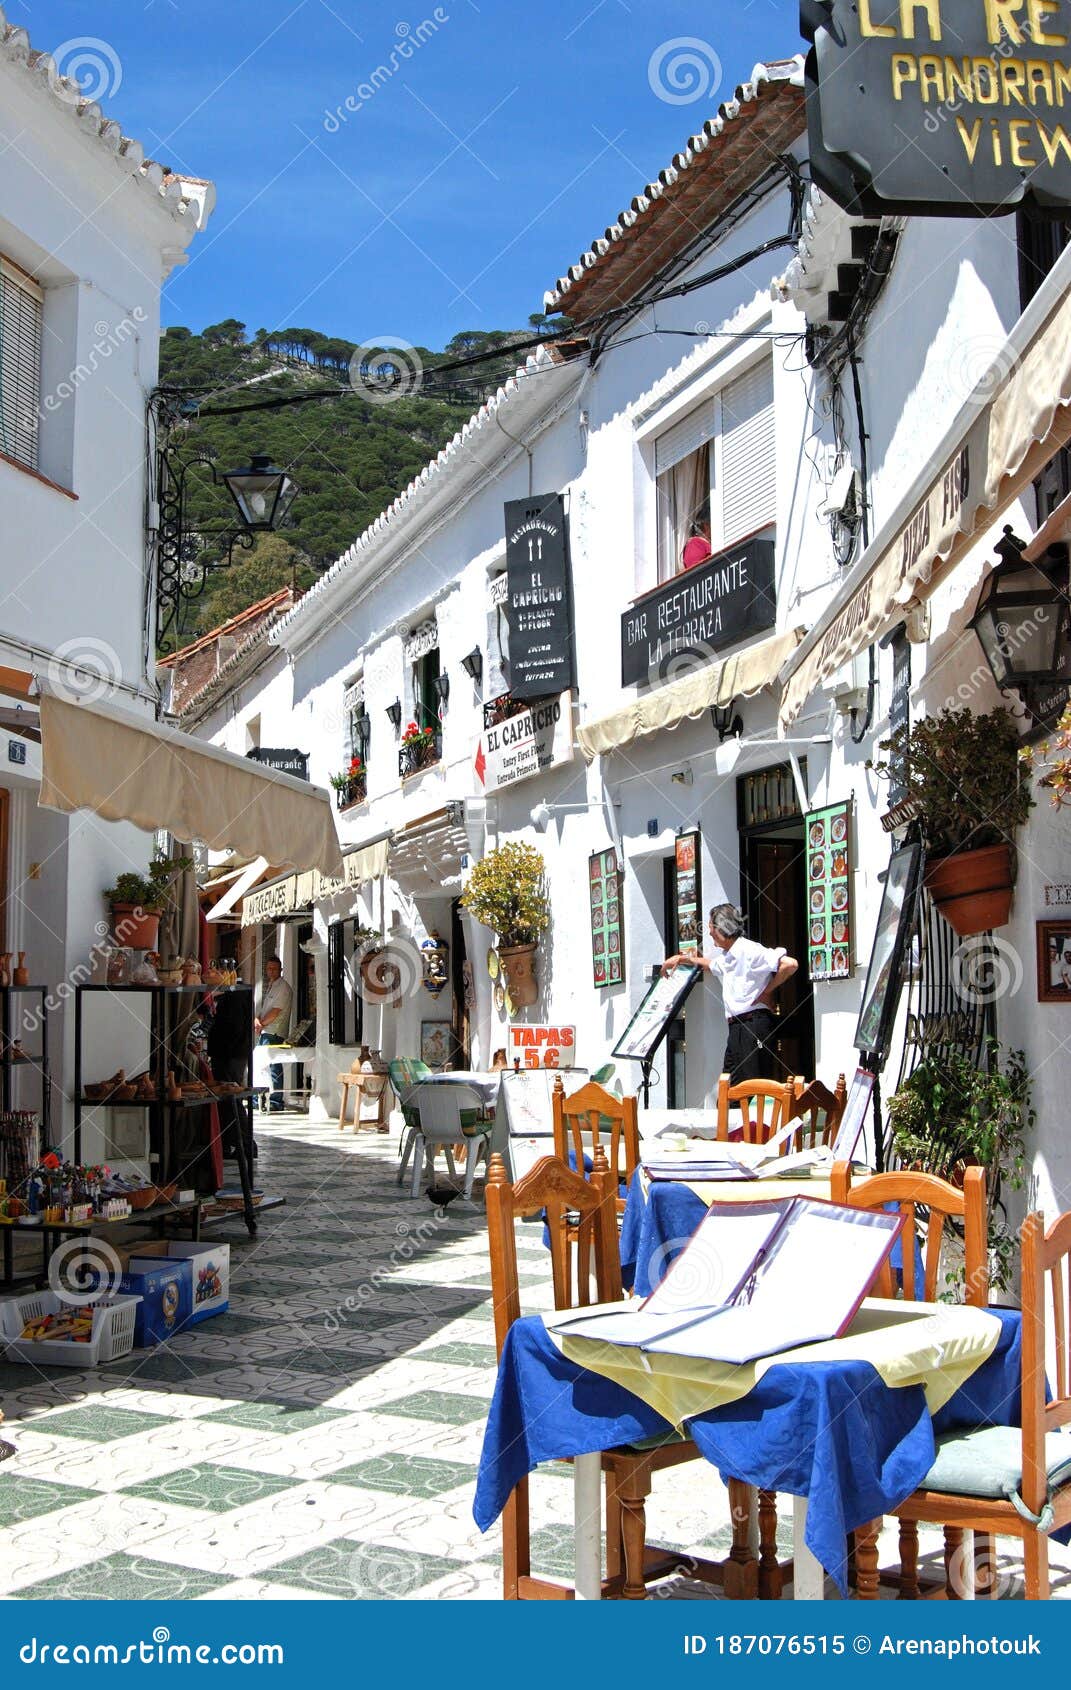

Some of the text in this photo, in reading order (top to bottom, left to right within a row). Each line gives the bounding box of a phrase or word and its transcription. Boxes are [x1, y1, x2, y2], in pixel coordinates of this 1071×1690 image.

[858, 0, 942, 41] LA
[510, 519, 558, 544] RESTAURANTE
[531, 572, 542, 587] EL
[513, 586, 563, 608] CAPRICHO
[627, 556, 747, 646] BAR RESTAURANTE
[528, 608, 555, 620] PLANTA
[648, 606, 722, 666] LA TERRAZA
[487, 701, 561, 752] EL CAPRICHO
[251, 757, 302, 770] staurante
[502, 756, 517, 768] Entry
[517, 749, 530, 761] First
[497, 768, 516, 784] Entrada
[516, 762, 537, 777] Primera
[510, 1027, 574, 1047] TAPAS
[524, 1048, 560, 1069] 5 €
